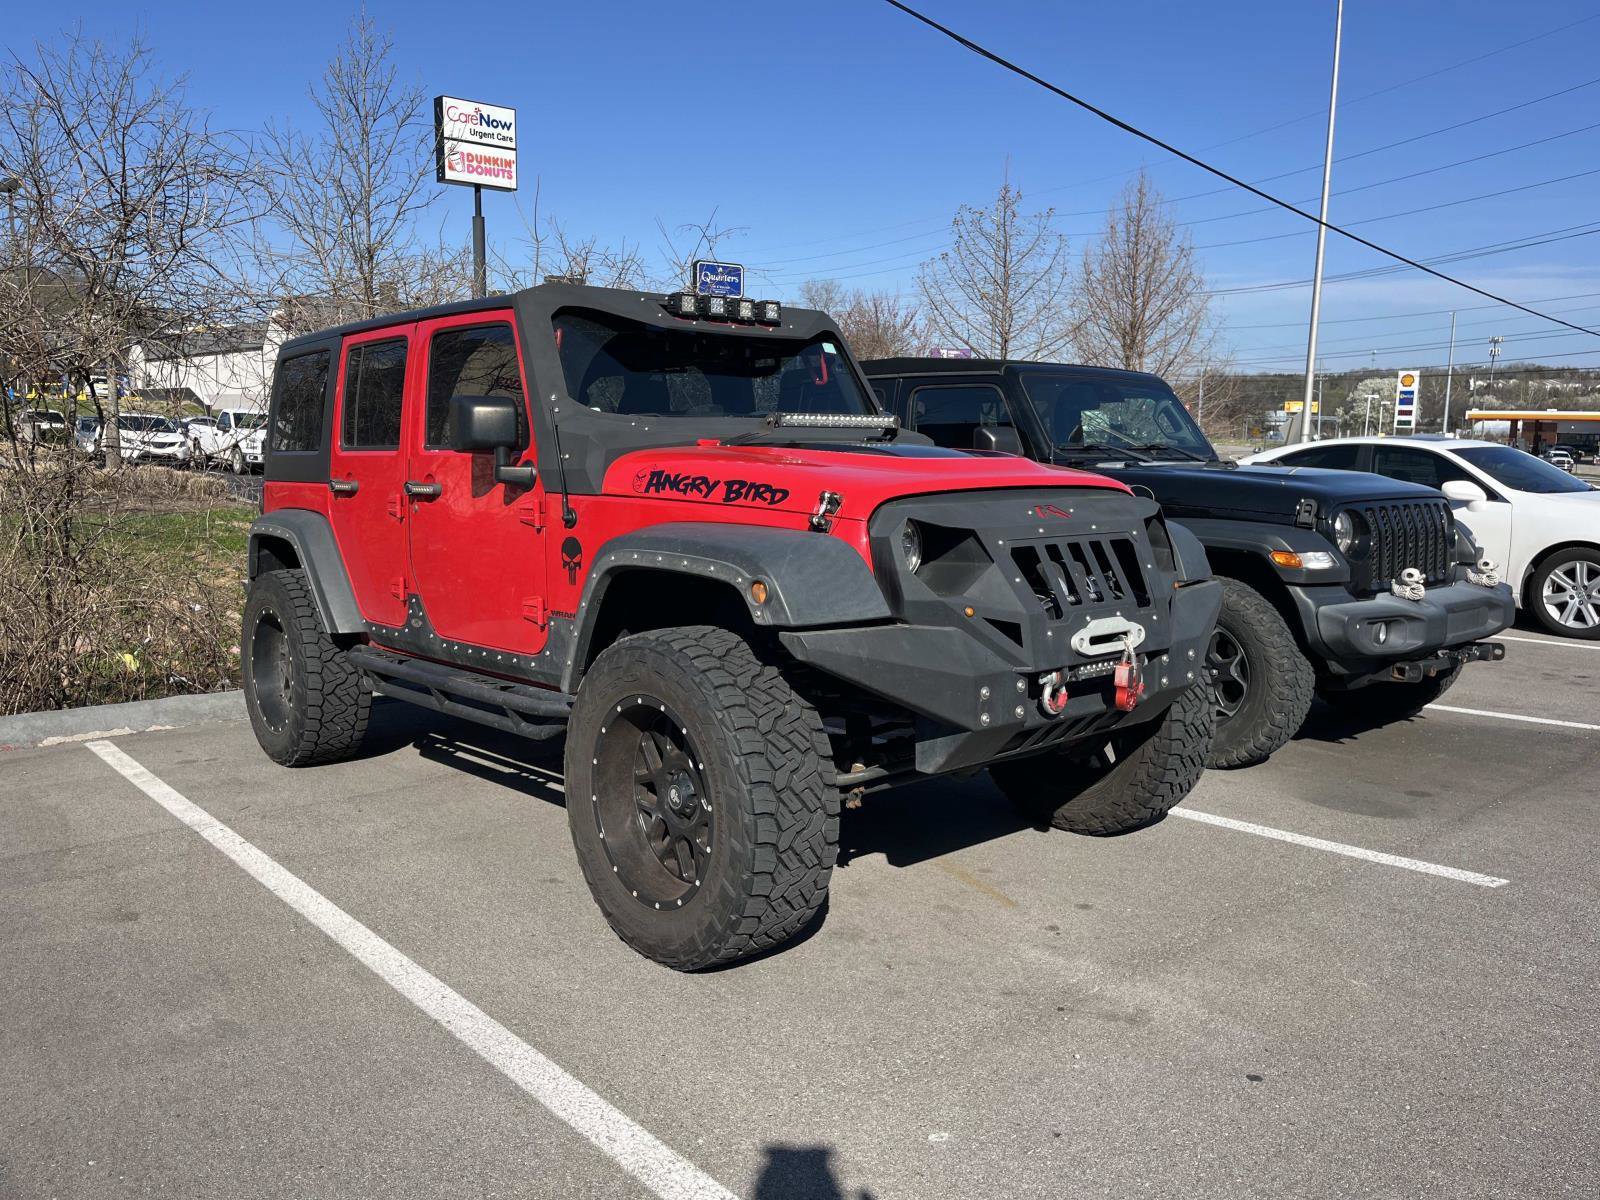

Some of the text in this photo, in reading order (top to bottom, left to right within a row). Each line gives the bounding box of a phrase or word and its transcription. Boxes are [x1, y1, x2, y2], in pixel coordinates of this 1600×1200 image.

[446, 106, 513, 131] CareNow
[469, 128, 514, 143] Urgent Care
[466, 152, 515, 170] DUNKIN'
[466, 163, 513, 180] DONUTS
[701, 270, 739, 284] Quarters
[644, 470, 790, 505] ANGRY BIRD
